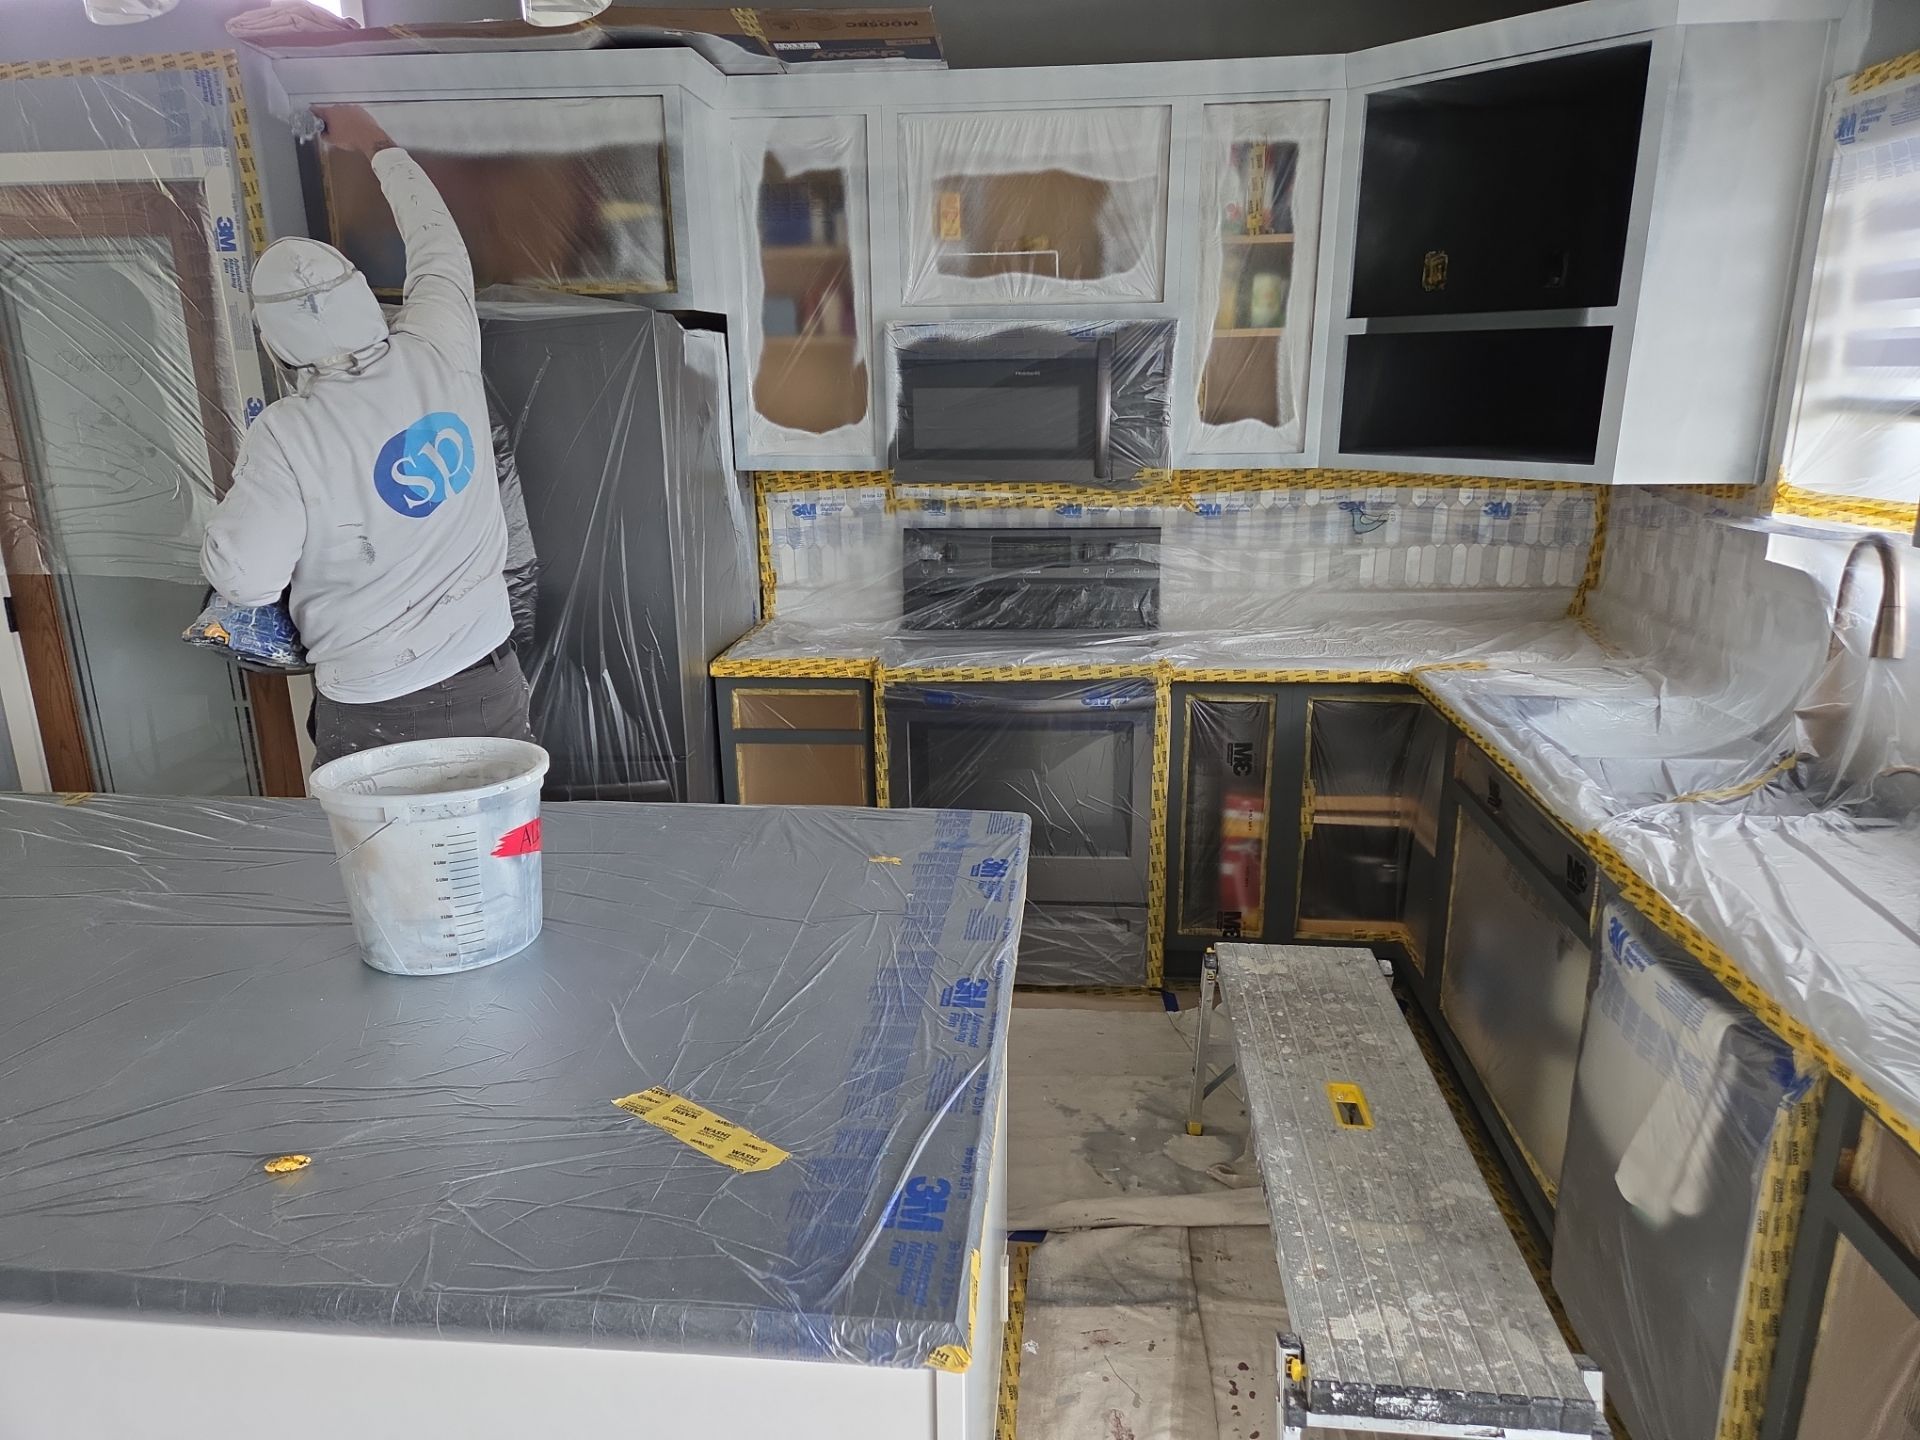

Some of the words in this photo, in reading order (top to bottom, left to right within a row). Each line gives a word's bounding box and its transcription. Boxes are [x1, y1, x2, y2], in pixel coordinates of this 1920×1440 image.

[215, 216, 237, 252] 3M
[391, 427, 464, 509] SP
[792, 503, 817, 517] 3M
[1196, 503, 1222, 516] 3M
[1483, 502, 1513, 517] 3M
[952, 978, 989, 1008] 3M
[948, 1012, 960, 1028] Film
[967, 1013, 984, 1048] Advanced
[671, 1108, 698, 1120] WASHI
[703, 1126, 732, 1140] WASHI
[731, 1149, 762, 1163] WASHI
[898, 1176, 952, 1232] 3M
[888, 1240, 906, 1267] Film
[896, 1241, 923, 1297] Masking
[913, 1241, 939, 1308] Advanced
